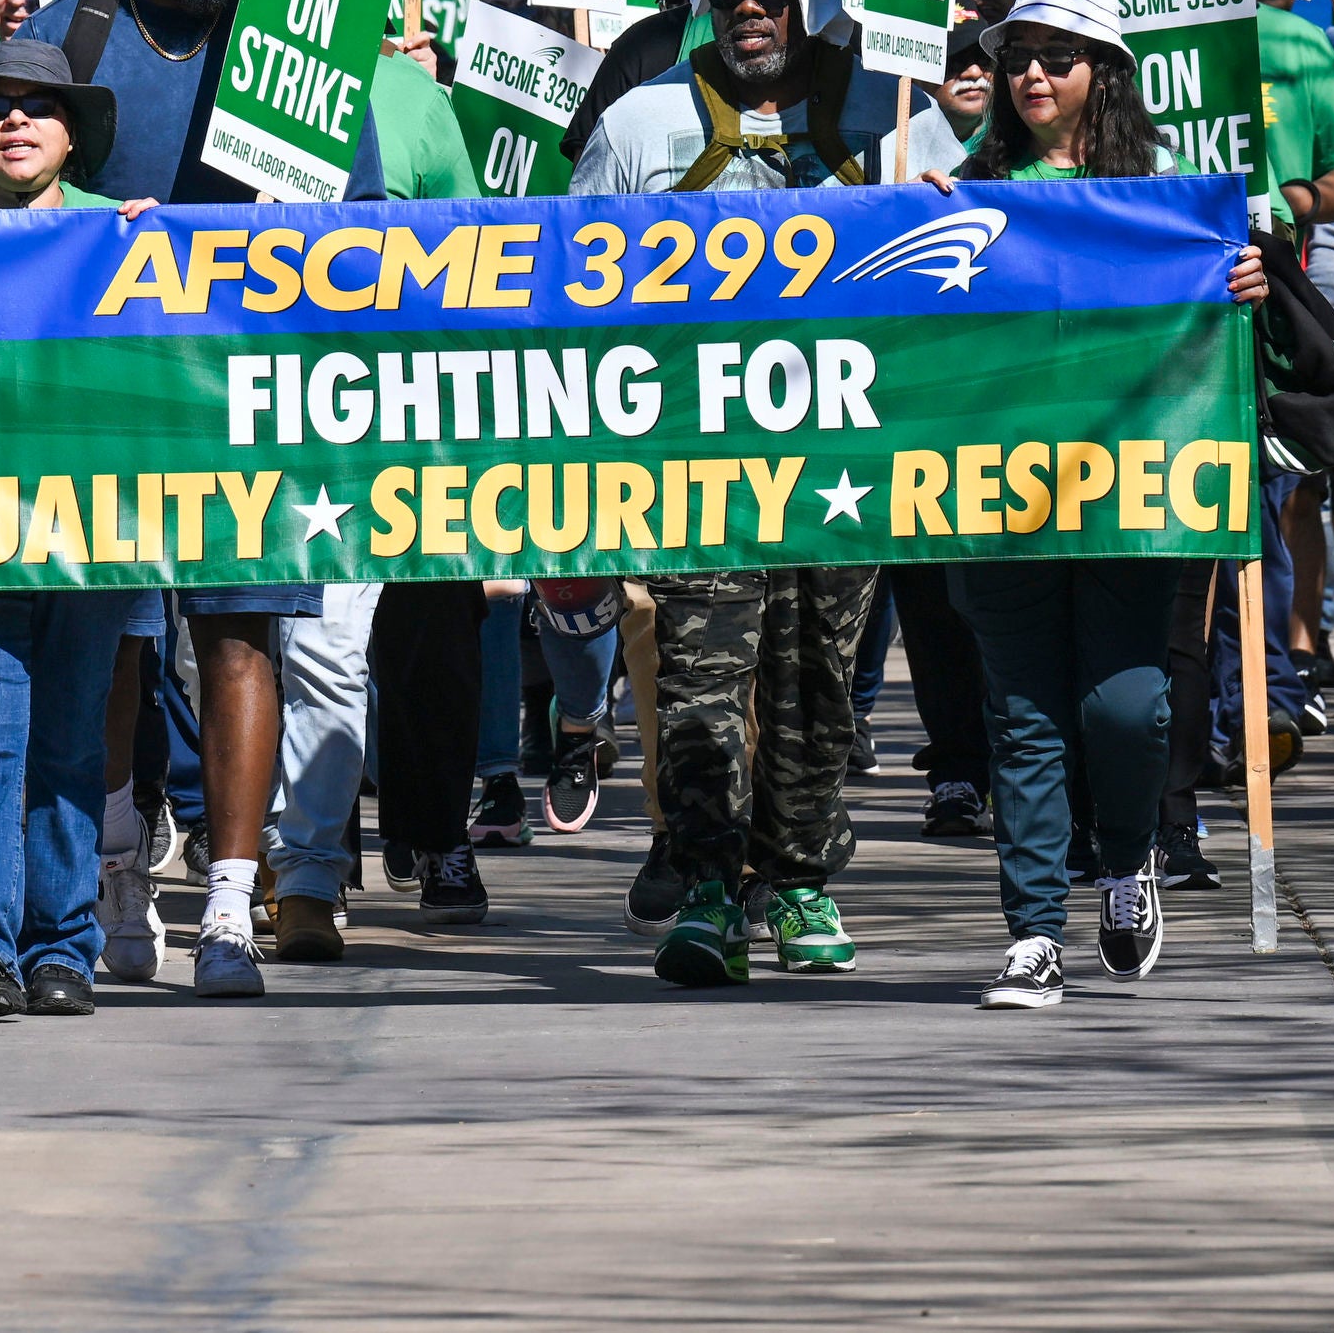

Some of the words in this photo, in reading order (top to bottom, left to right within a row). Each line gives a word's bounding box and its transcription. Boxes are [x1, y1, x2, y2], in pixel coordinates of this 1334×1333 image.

[230, 25, 363, 144] STRIKE
[469, 42, 545, 99] AFSCME
[544, 73, 588, 114] 3299
[867, 29, 891, 53] UNFAIR
[892, 34, 914, 58] LABOR
[915, 41, 943, 67] PRACTICE
[1141, 48, 1203, 115] ON
[212, 128, 252, 164] UNFAIR
[251, 149, 284, 180] LABOR
[286, 163, 338, 203] PRACTICE
[483, 127, 538, 198] ON
[94, 223, 541, 317] AFSCME
[563, 213, 837, 309] 3299
[227, 344, 663, 447] FIGHTING
[697, 338, 883, 436] FOR
[369, 456, 807, 559] SECURITY
